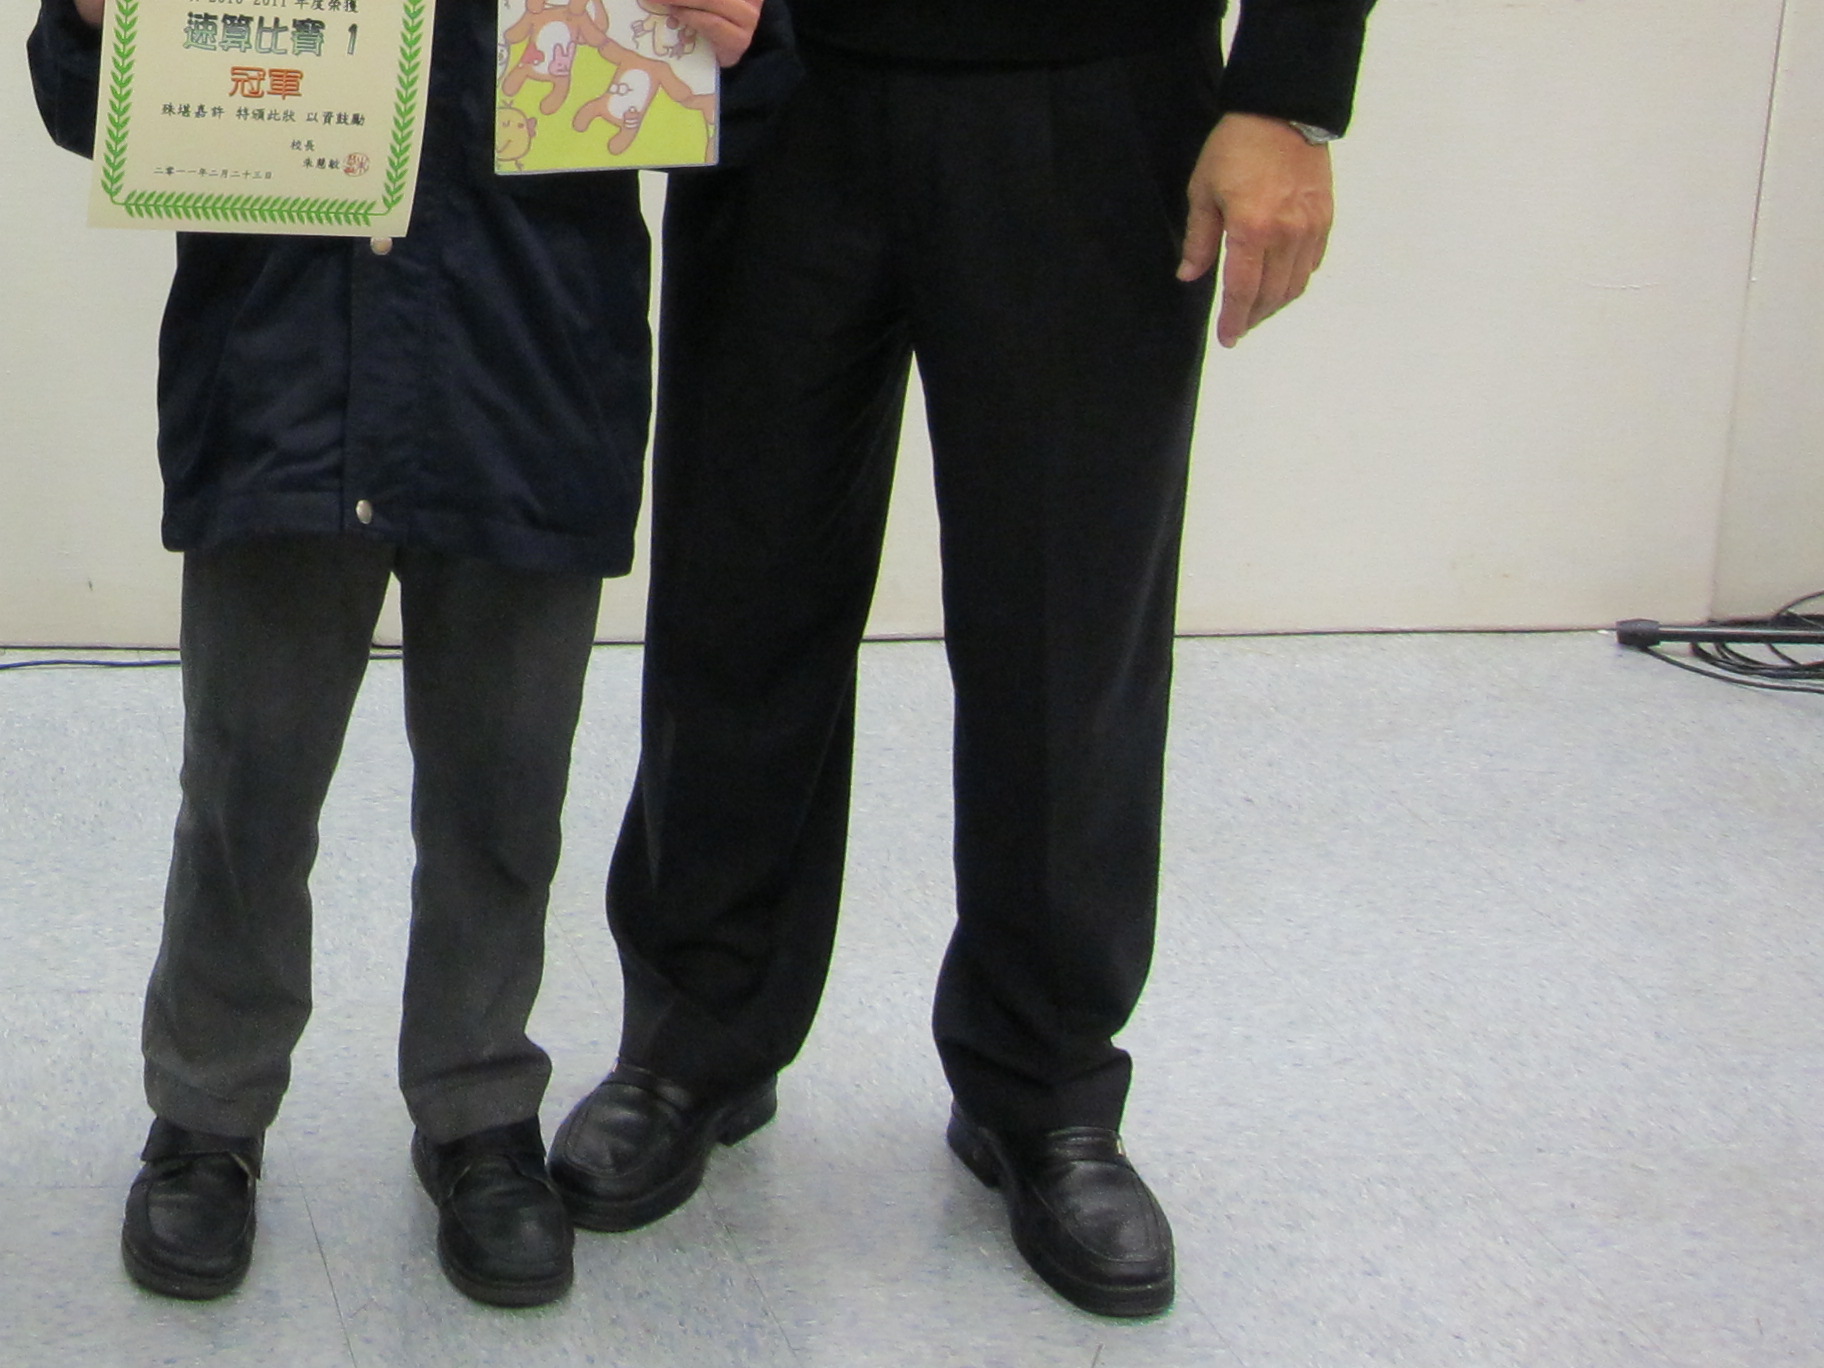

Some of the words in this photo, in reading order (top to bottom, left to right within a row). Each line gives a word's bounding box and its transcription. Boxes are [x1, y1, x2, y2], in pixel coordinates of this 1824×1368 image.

[182, 11, 326, 57] 速算比賽
[347, 23, 358, 55] 1
[228, 65, 304, 101] 冠軍
[290, 139, 316, 152] 校長
